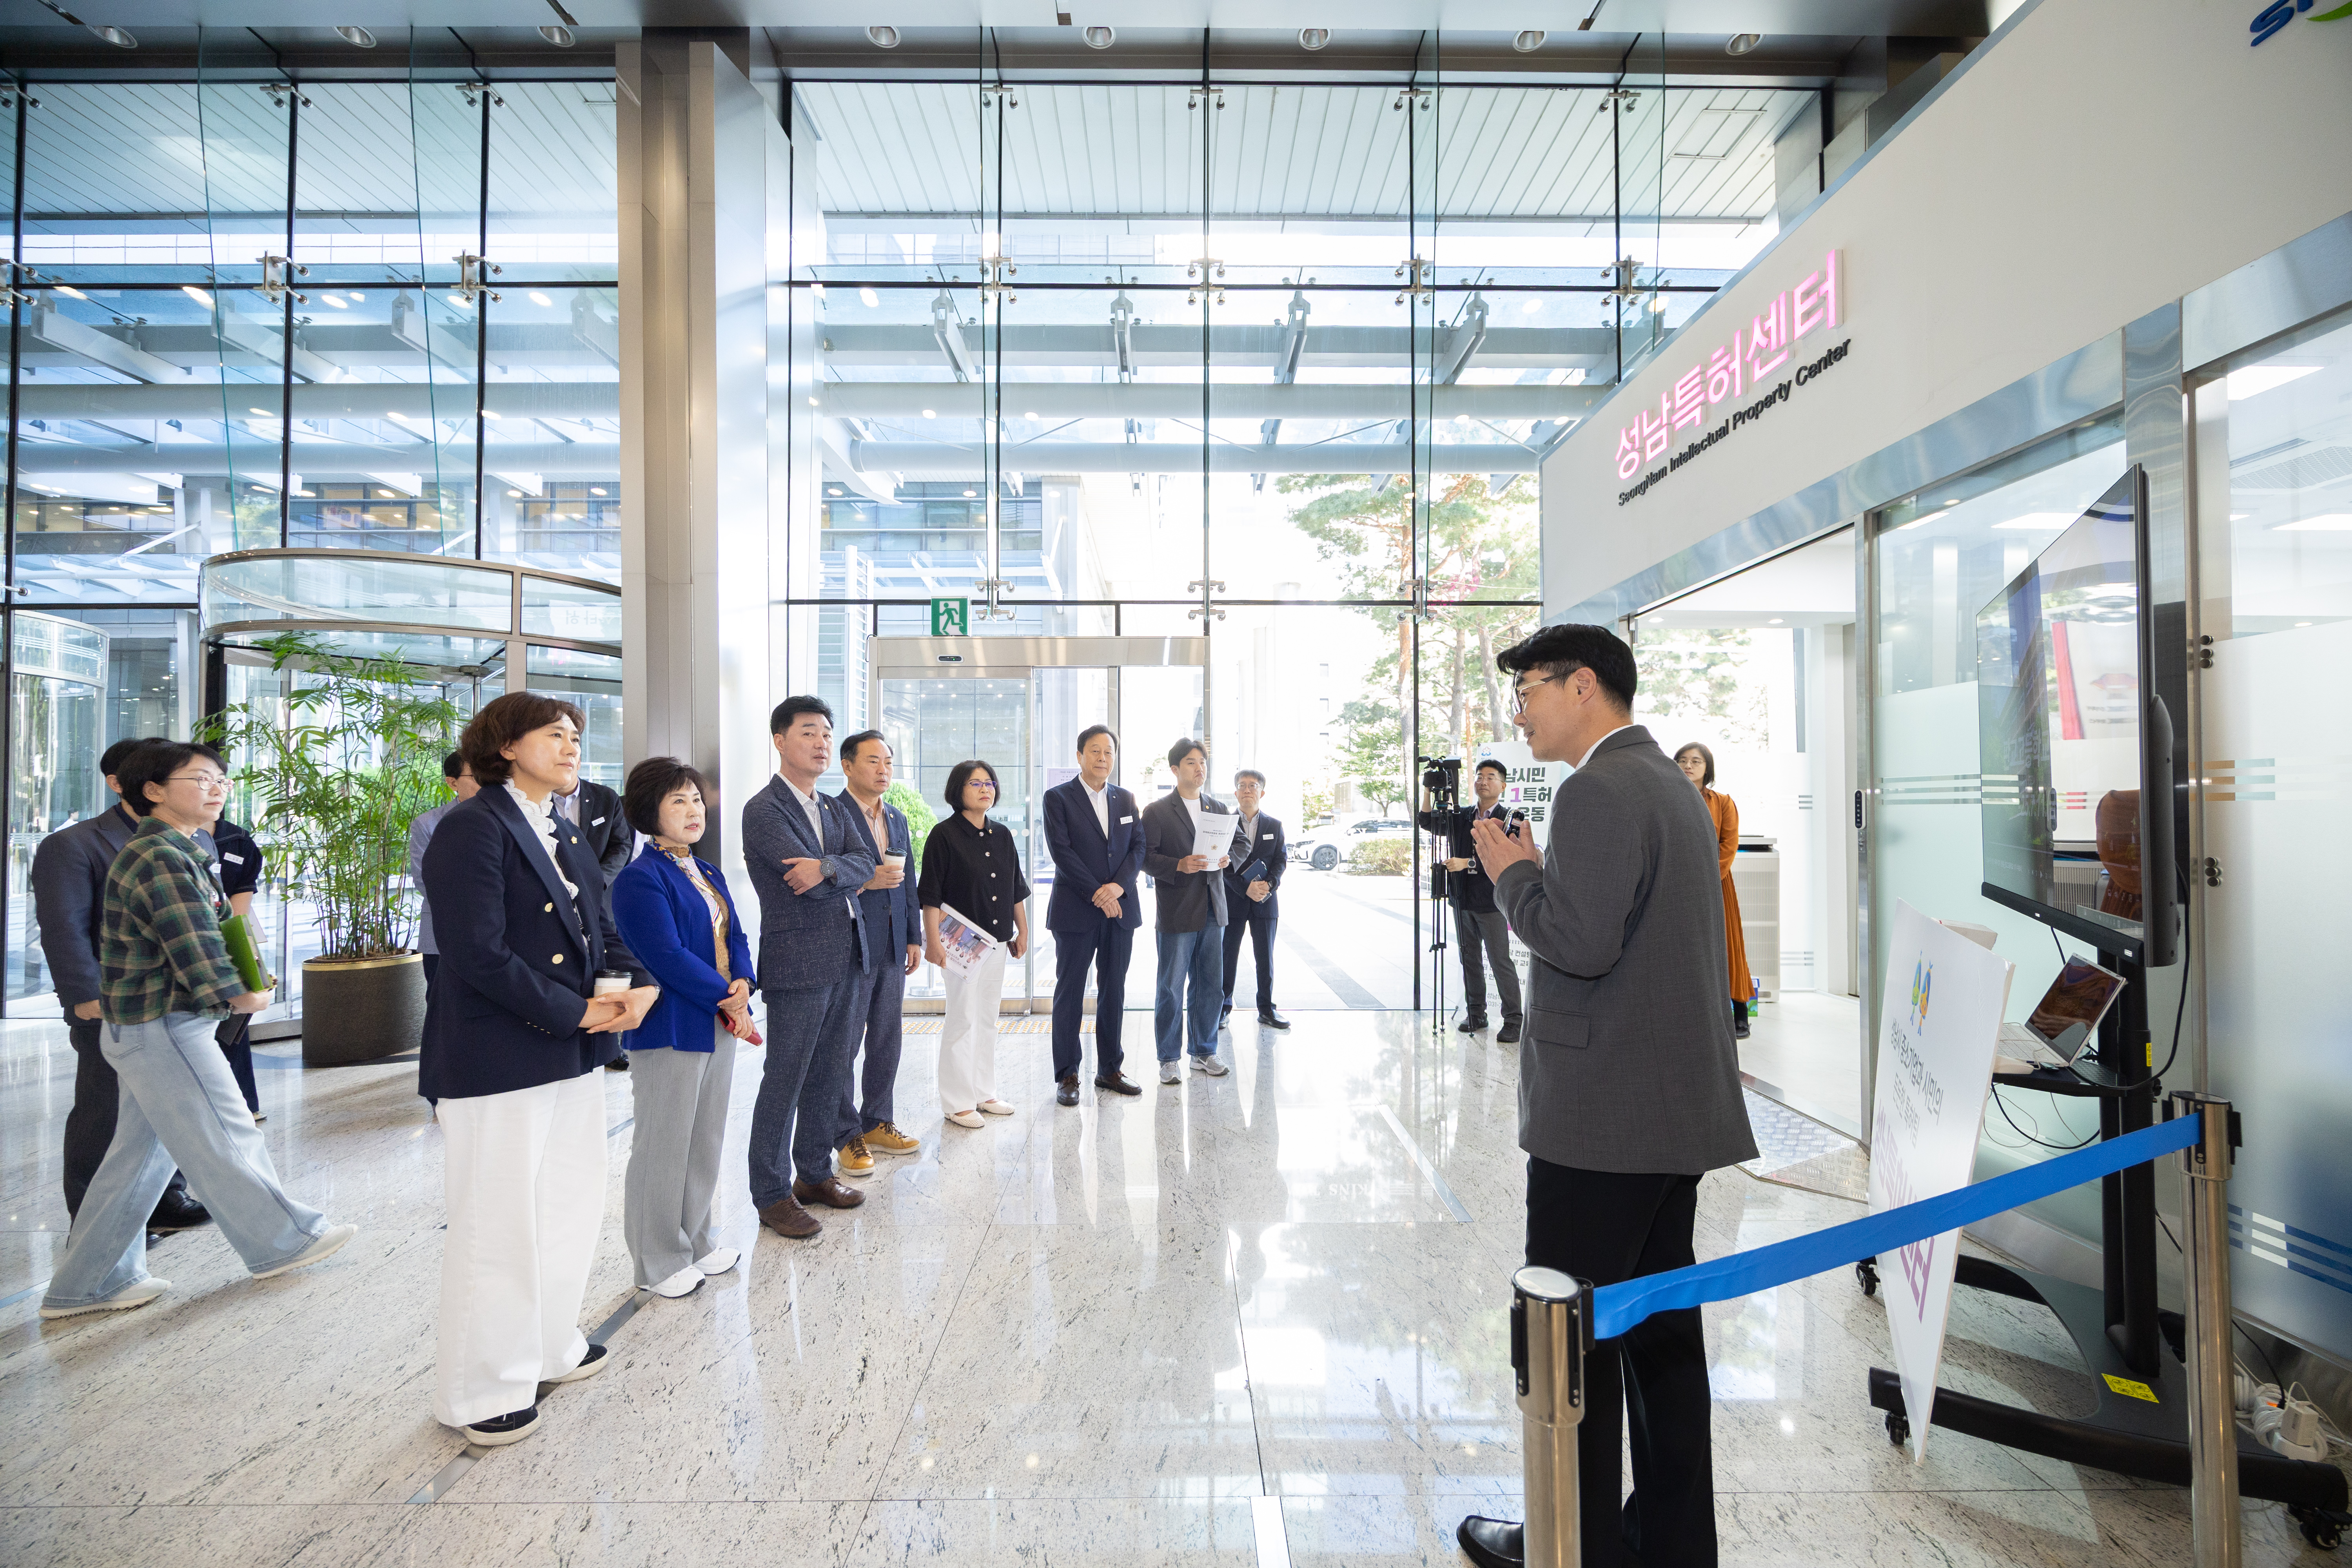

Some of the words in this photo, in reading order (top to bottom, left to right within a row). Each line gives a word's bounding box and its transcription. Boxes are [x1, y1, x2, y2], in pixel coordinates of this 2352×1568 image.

[1614, 249, 1843, 479] 성남특허센터
[1618, 462, 1667, 506] SeongNam
[1670, 419, 1729, 473] Intellectual
[1733, 379, 1791, 430] Property
[1795, 338, 1851, 386] Center
[1506, 767, 1546, 783] 남시민
[1510, 787, 1552, 802] 1특허
[1891, 1017, 1902, 1058] 성남시
[1900, 1033, 1924, 1095] 중소기업과
[1922, 1071, 1943, 1126] 시민의
[1893, 1072, 1906, 1119] 든든한
